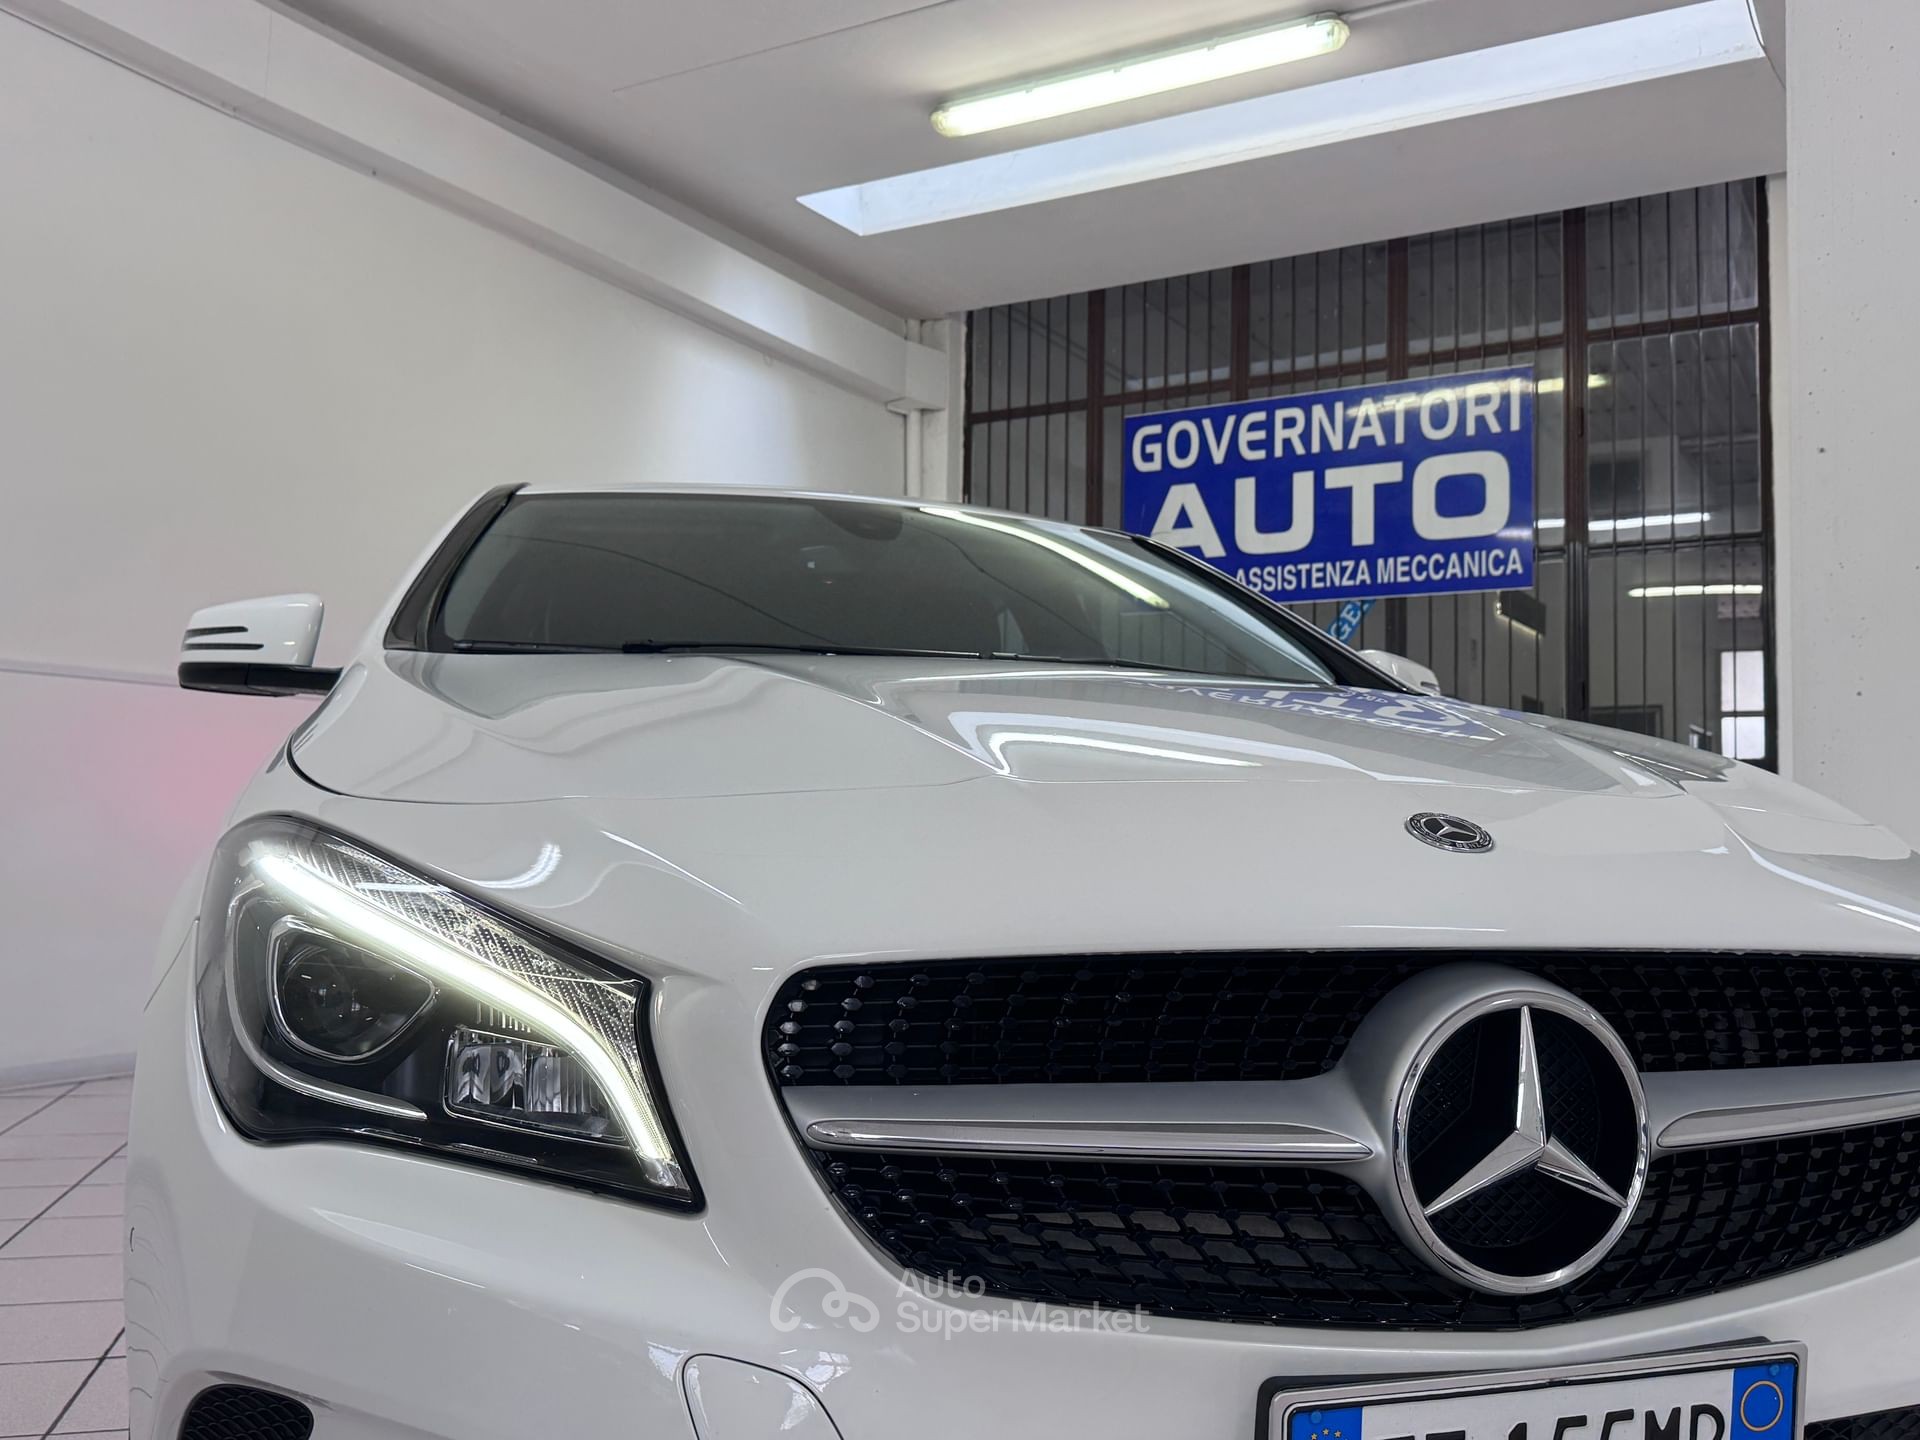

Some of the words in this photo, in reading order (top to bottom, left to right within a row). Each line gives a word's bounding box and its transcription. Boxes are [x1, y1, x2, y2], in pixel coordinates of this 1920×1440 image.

[1132, 378, 1521, 473] GOVERNATORI
[1151, 450, 1511, 559] AUTO
[1236, 559, 1371, 593] ASSISTENZA
[1377, 548, 1524, 584] MECCANICA
